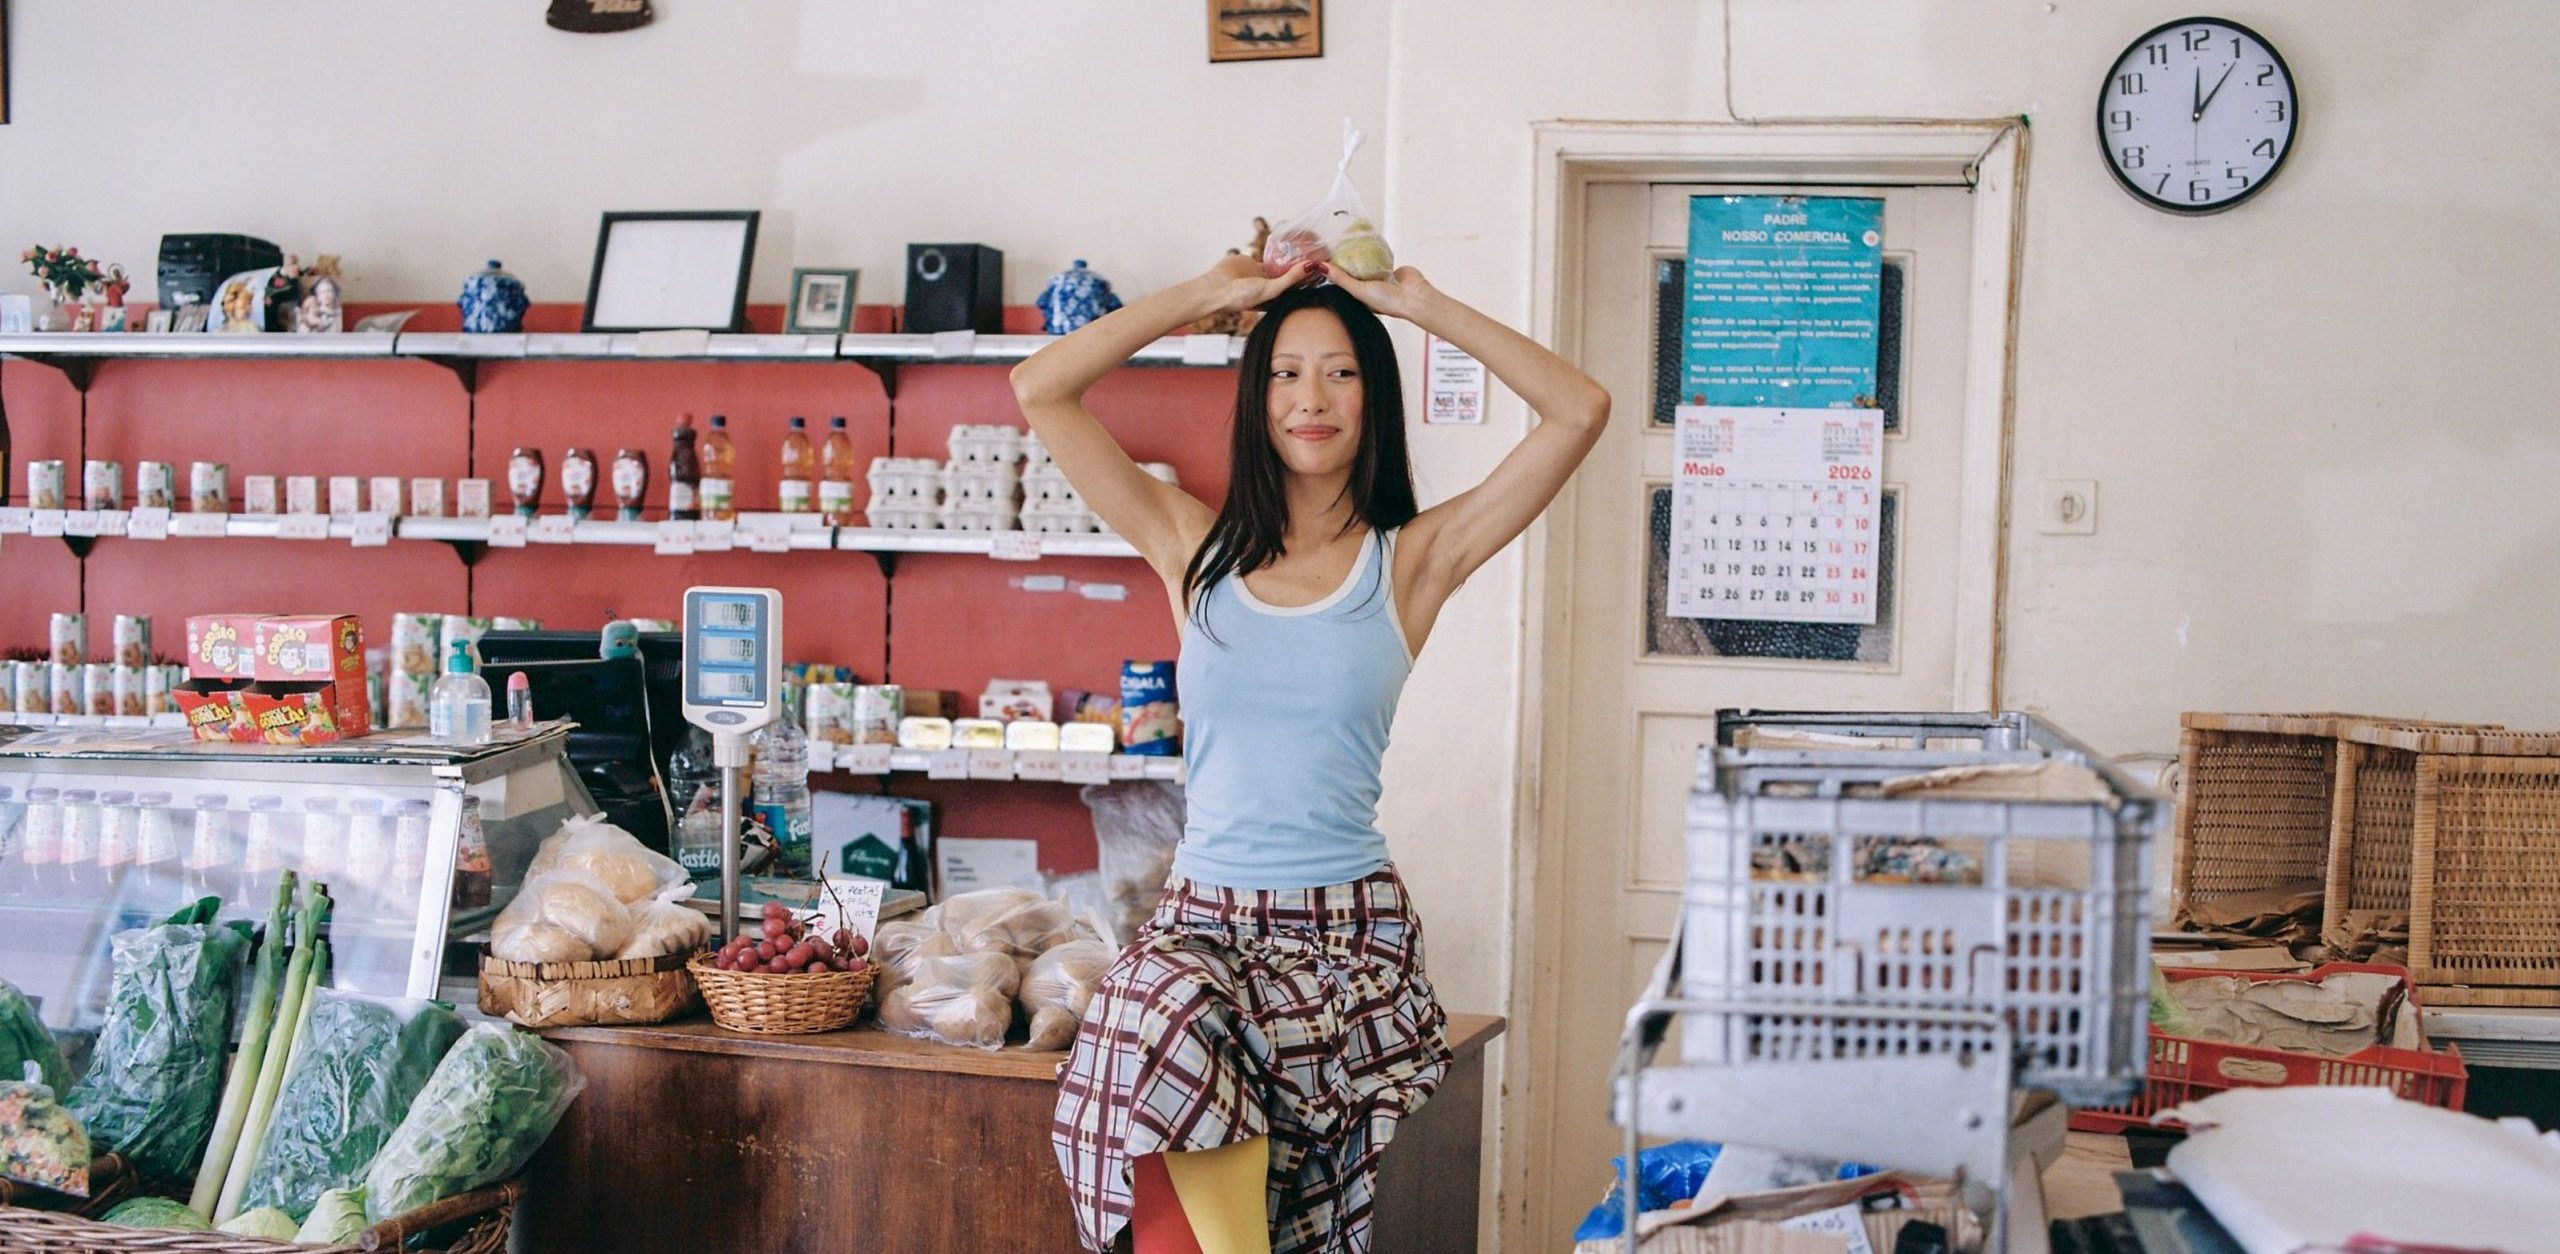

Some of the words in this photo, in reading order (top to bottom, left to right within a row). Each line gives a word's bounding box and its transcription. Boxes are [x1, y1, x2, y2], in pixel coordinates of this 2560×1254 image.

[2181, 29, 2210, 51] 12
[2230, 37, 2241, 59] 1
[2145, 43, 2167, 65] 11
[2118, 73, 2142, 95] 10
[2257, 64, 2274, 86] 2
[2111, 110, 2131, 133] 9
[2264, 100, 2284, 123] 3
[2122, 146, 2144, 169] 8
[2252, 138, 2275, 159] 4
[2152, 173, 2171, 195] 7
[2226, 166, 2248, 189] 5
[2189, 179, 2210, 202] 6
[1763, 213, 1808, 225] PADRE
[1722, 230, 1768, 241] NOSSO
[1774, 231, 1850, 243] COMERCIAL
[1684, 461, 1725, 476] Maio
[1828, 465, 1872, 480] 2026
[1837, 493, 1844, 503] 2
[1710, 515, 1717, 525] 4
[1735, 516, 1742, 526] 5
[1760, 516, 1767, 527] 6
[1786, 517, 1792, 527] 7
[1811, 517, 1818, 528] 8
[1836, 518, 1842, 529] 9
[1856, 519, 1868, 530] 10
[1704, 539, 1716, 549] 11
[1729, 540, 1741, 550] 12
[1753, 540, 1766, 551] 13
[1779, 541, 1791, 552] 14
[1804, 542, 1816, 553] 15
[1829, 542, 1842, 554] 16
[1854, 543, 1867, 554] 17
[1702, 563, 1715, 574] 18
[1727, 564, 1741, 575] 19
[1751, 565, 1765, 576] 20
[1777, 566, 1791, 577] 21
[1802, 566, 1816, 577] 22
[1826, 567, 1840, 578] 23
[1852, 568, 1866, 579] 24
[1700, 588, 1714, 599] 25
[1725, 589, 1739, 600] 26
[1750, 590, 1764, 601] 27
[1775, 590, 1789, 601] 28
[1800, 591, 1814, 602] 29
[1825, 592, 1839, 603] 30
[1851, 593, 1865, 604] 31
[679, 847, 721, 868] fastio
